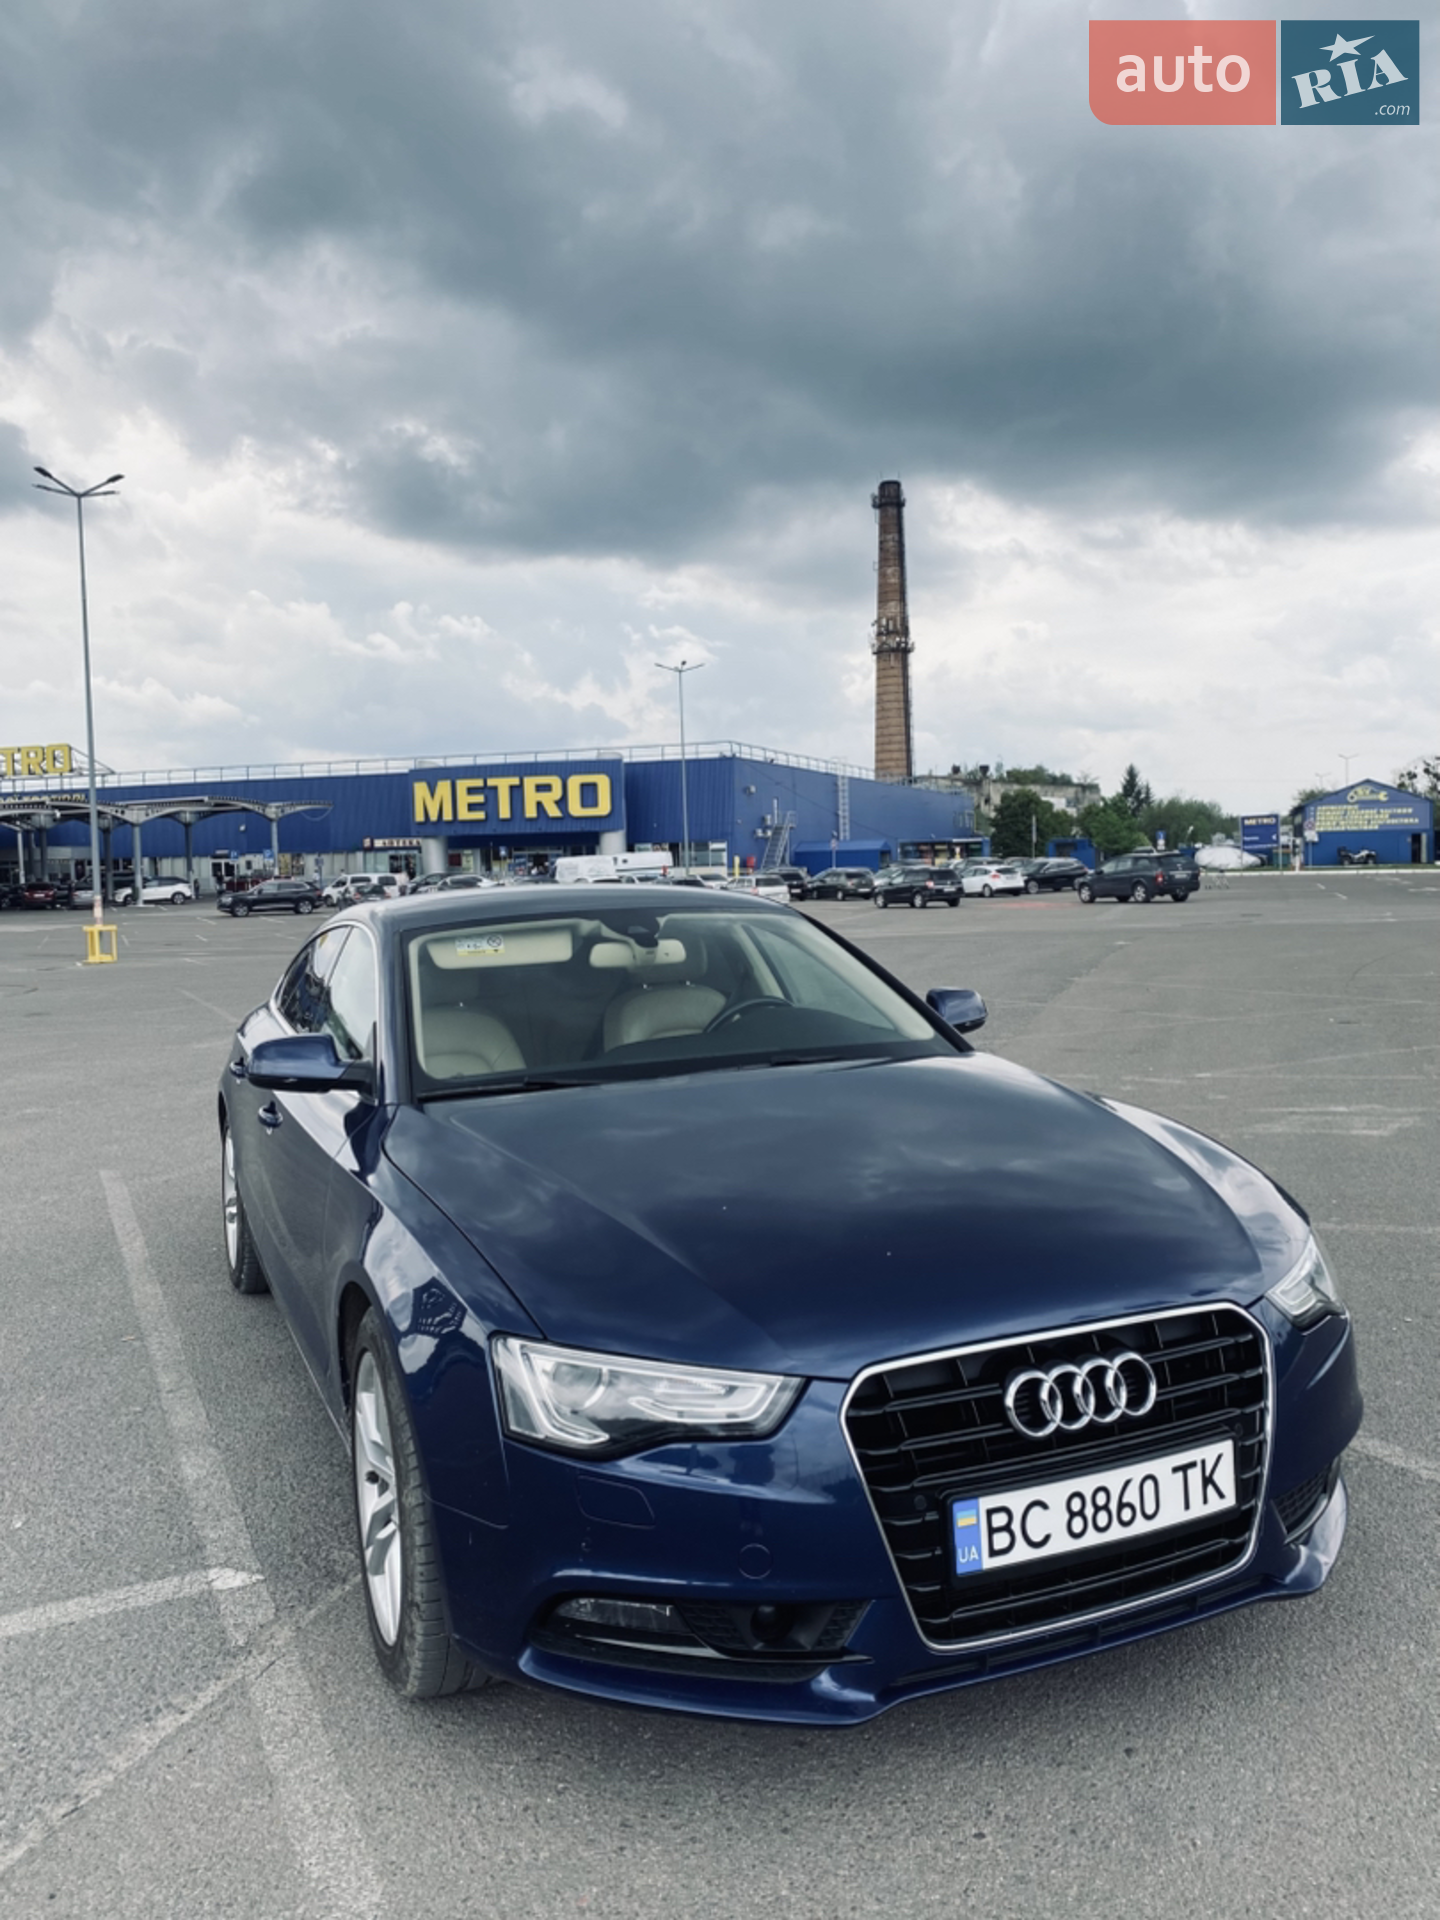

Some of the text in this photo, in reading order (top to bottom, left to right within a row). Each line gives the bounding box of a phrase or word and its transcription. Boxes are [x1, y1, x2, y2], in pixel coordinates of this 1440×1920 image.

[413, 773, 612, 823] METRO
[985, 1453, 1226, 1558] BC 8860 TK
[957, 1547, 979, 1564] UA
